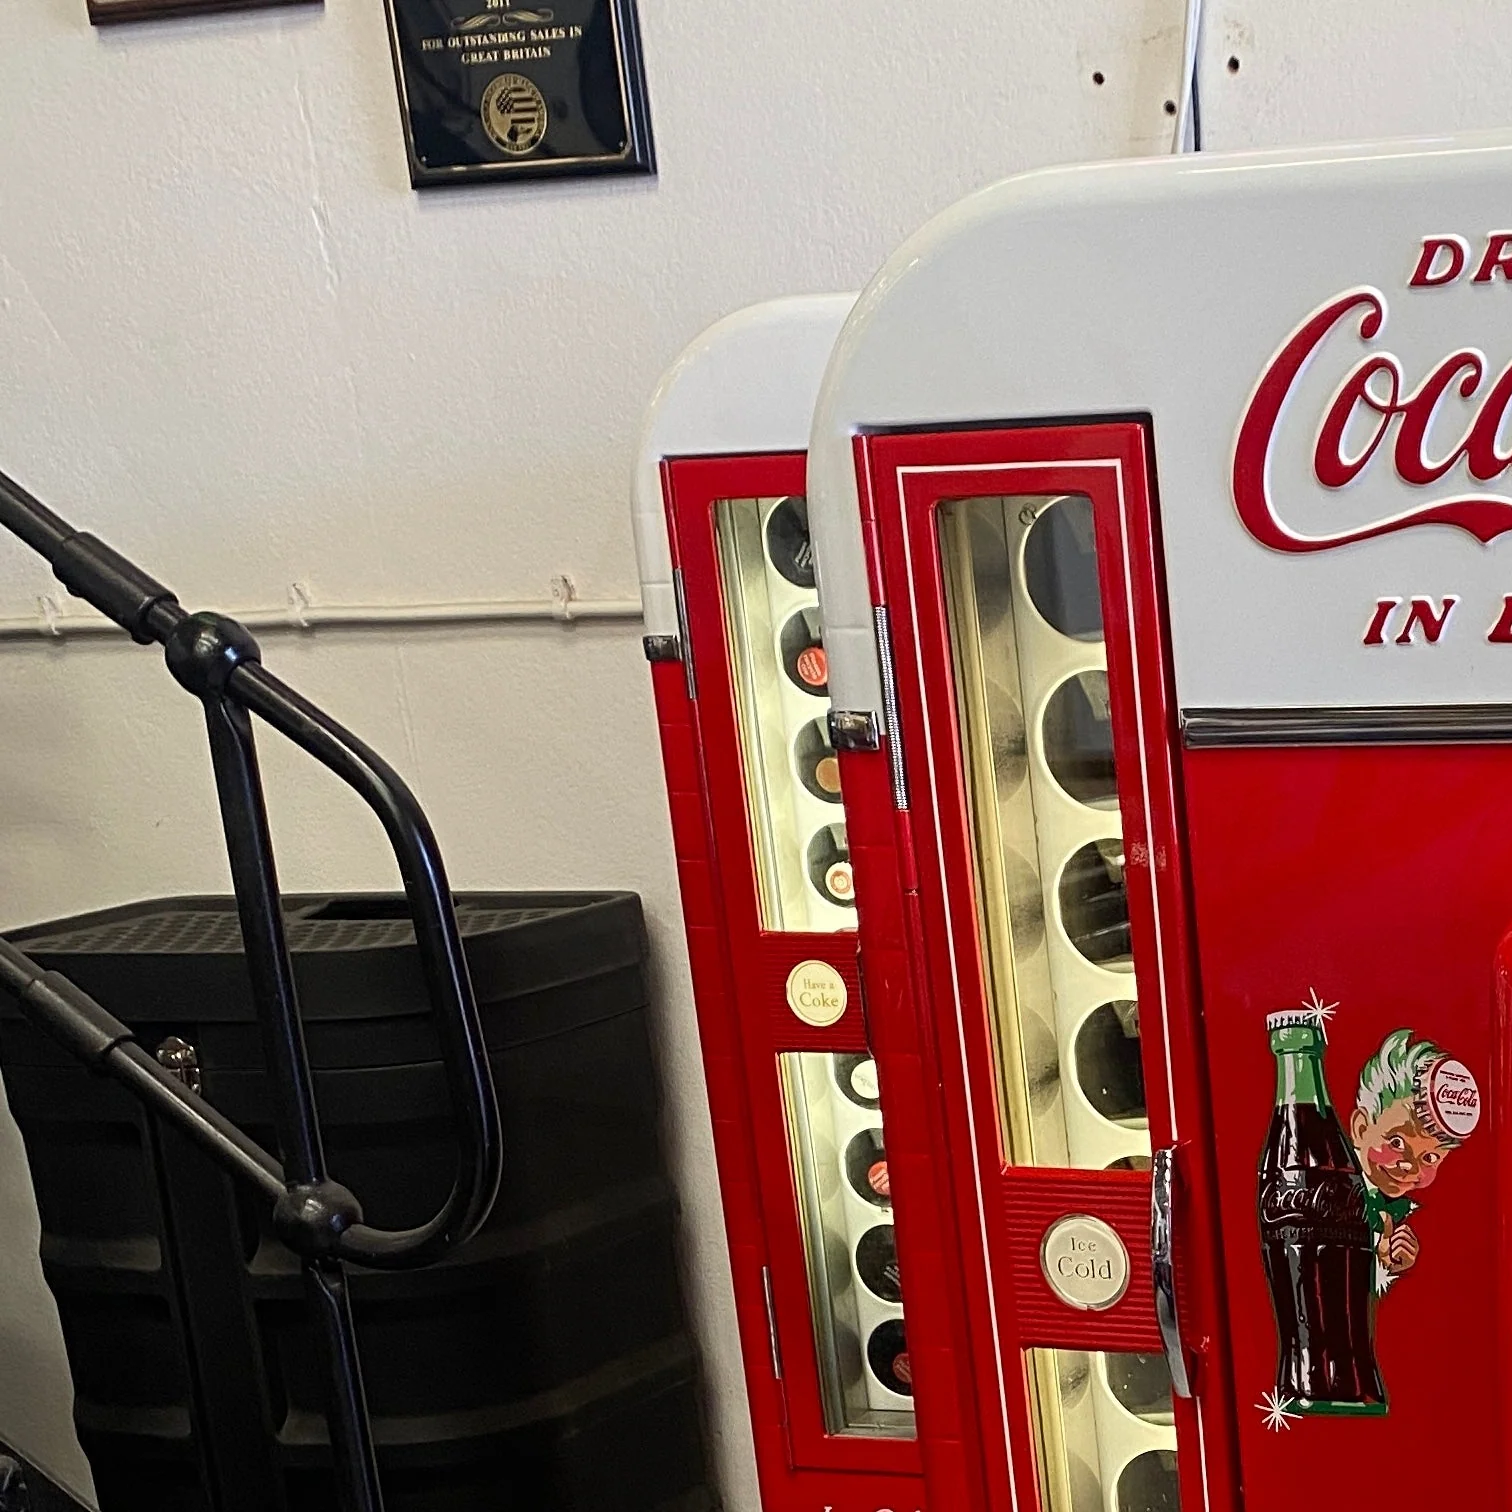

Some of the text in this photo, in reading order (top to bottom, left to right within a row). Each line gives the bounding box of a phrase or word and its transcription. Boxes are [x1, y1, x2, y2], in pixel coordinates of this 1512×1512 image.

[422, 25, 582, 50] FOR OUTSTANDING SALES IN
[461, 46, 551, 64] GREAT BRITAIN
[1363, 596, 1457, 648] IN
[803, 978, 835, 990] Have a
[799, 991, 839, 1008] Coke
[1070, 1237, 1097, 1252] Ice
[1057, 1256, 1112, 1280] Cold
